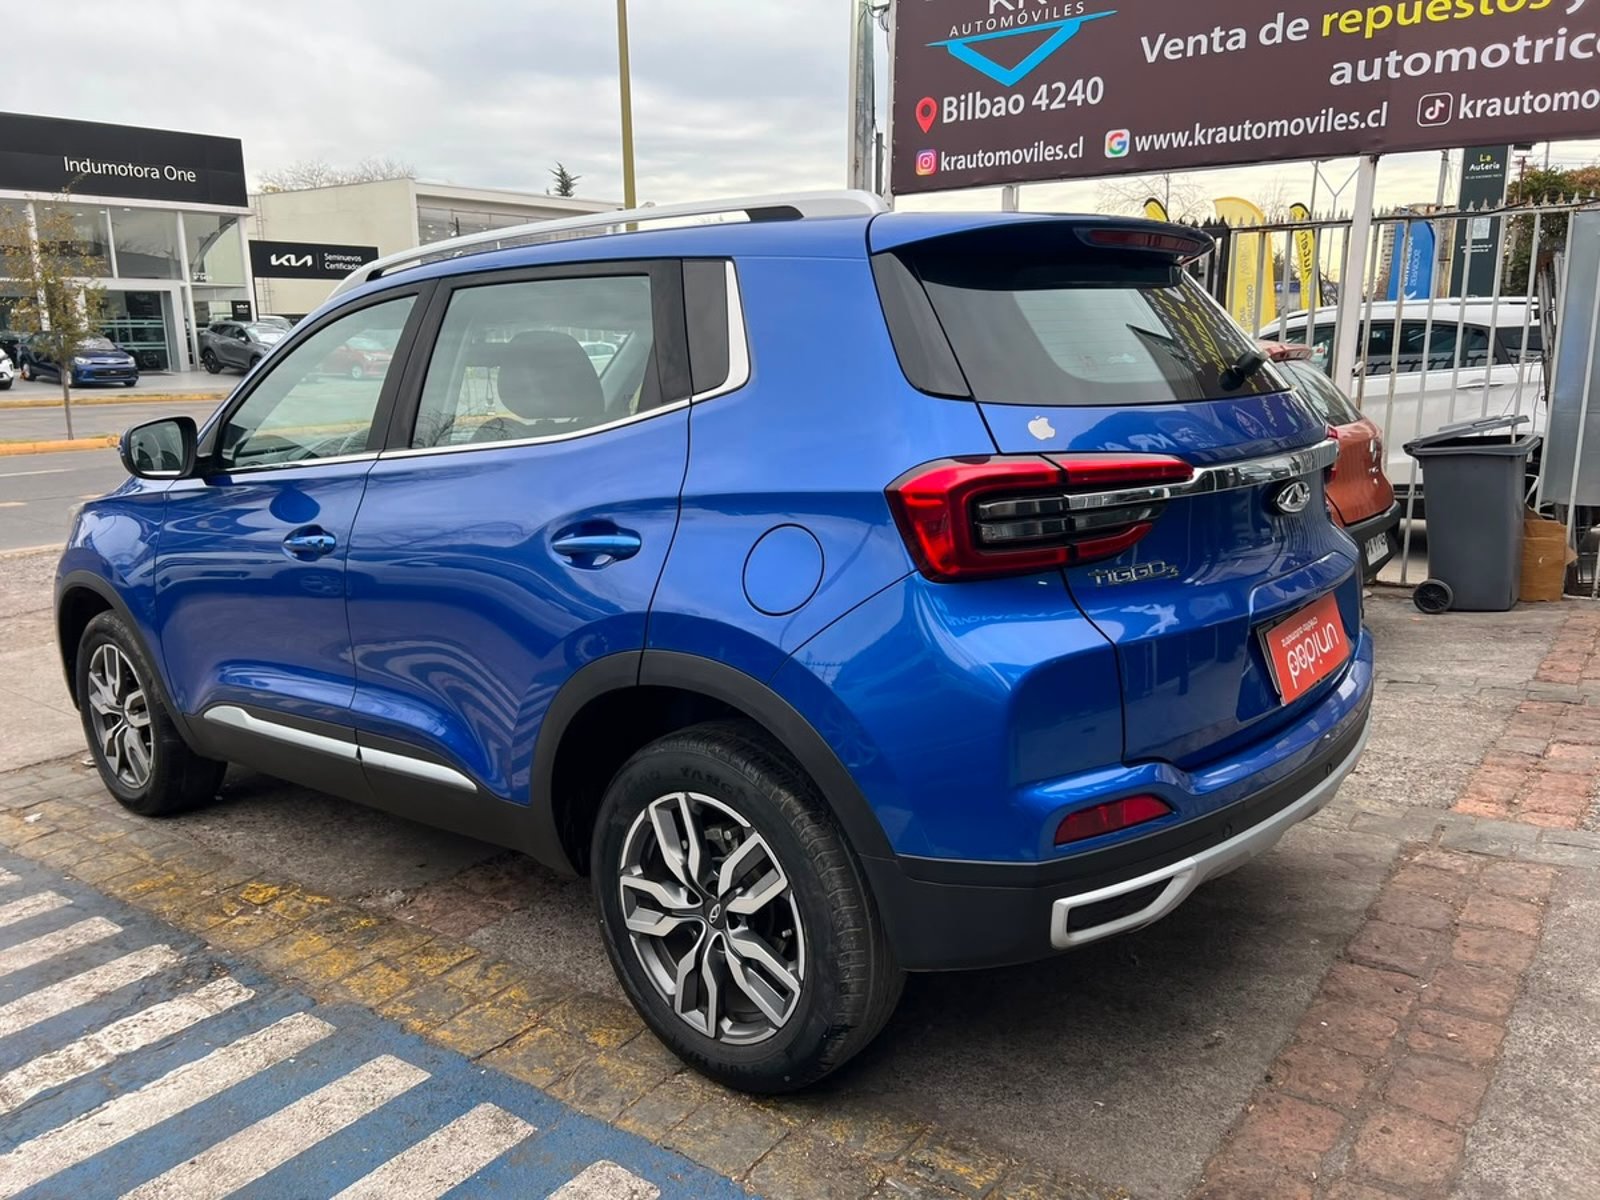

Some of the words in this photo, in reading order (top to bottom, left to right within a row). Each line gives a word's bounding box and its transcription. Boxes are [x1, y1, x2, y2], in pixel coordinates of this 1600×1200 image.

[948, 1, 1085, 37] AUTOMÓVILES
[1140, 26, 1247, 63] Venta
[1258, 12, 1310, 46] de
[1329, 27, 1600, 86] automotric
[942, 91, 1025, 123] Bilbao
[1032, 76, 1104, 111] 4240
[1458, 88, 1600, 120] krautomo
[1135, 101, 1389, 152] www.krautomoviles.cl
[63, 156, 160, 179] Indumotora
[163, 165, 197, 183] One
[940, 136, 1084, 171] krautomoviles.cl
